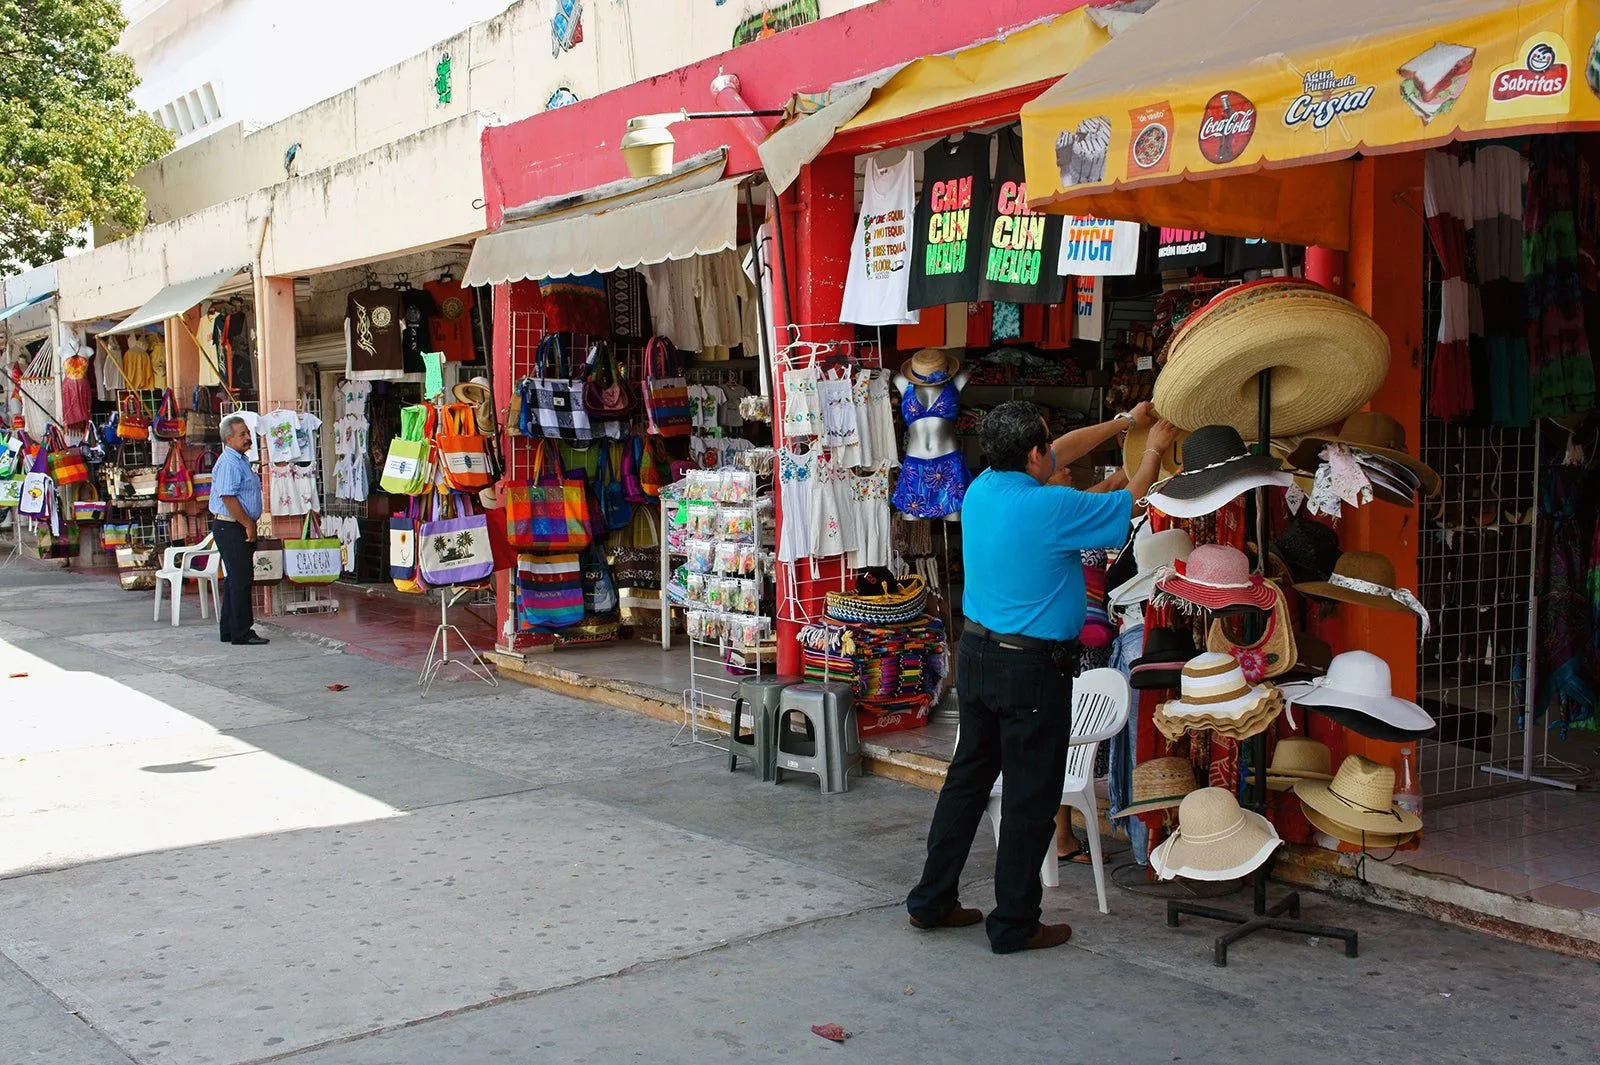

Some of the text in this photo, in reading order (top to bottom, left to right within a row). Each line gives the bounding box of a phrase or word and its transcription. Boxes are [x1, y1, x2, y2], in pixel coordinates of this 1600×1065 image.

[1304, 70, 1334, 82] Agua
[1304, 74, 1356, 92] Purificada
[1498, 74, 1562, 92] Sabritas
[1285, 85, 1375, 128] Cristal
[1200, 109, 1254, 140] Coca-Cola
[931, 175, 973, 213] CAN
[997, 181, 1044, 215] CA
[928, 208, 970, 244] CUN
[991, 215, 1046, 250] CUN
[872, 259, 891, 272] FLOOR
[925, 240, 967, 276] MEXICO
[986, 247, 1041, 285] MEXICO
